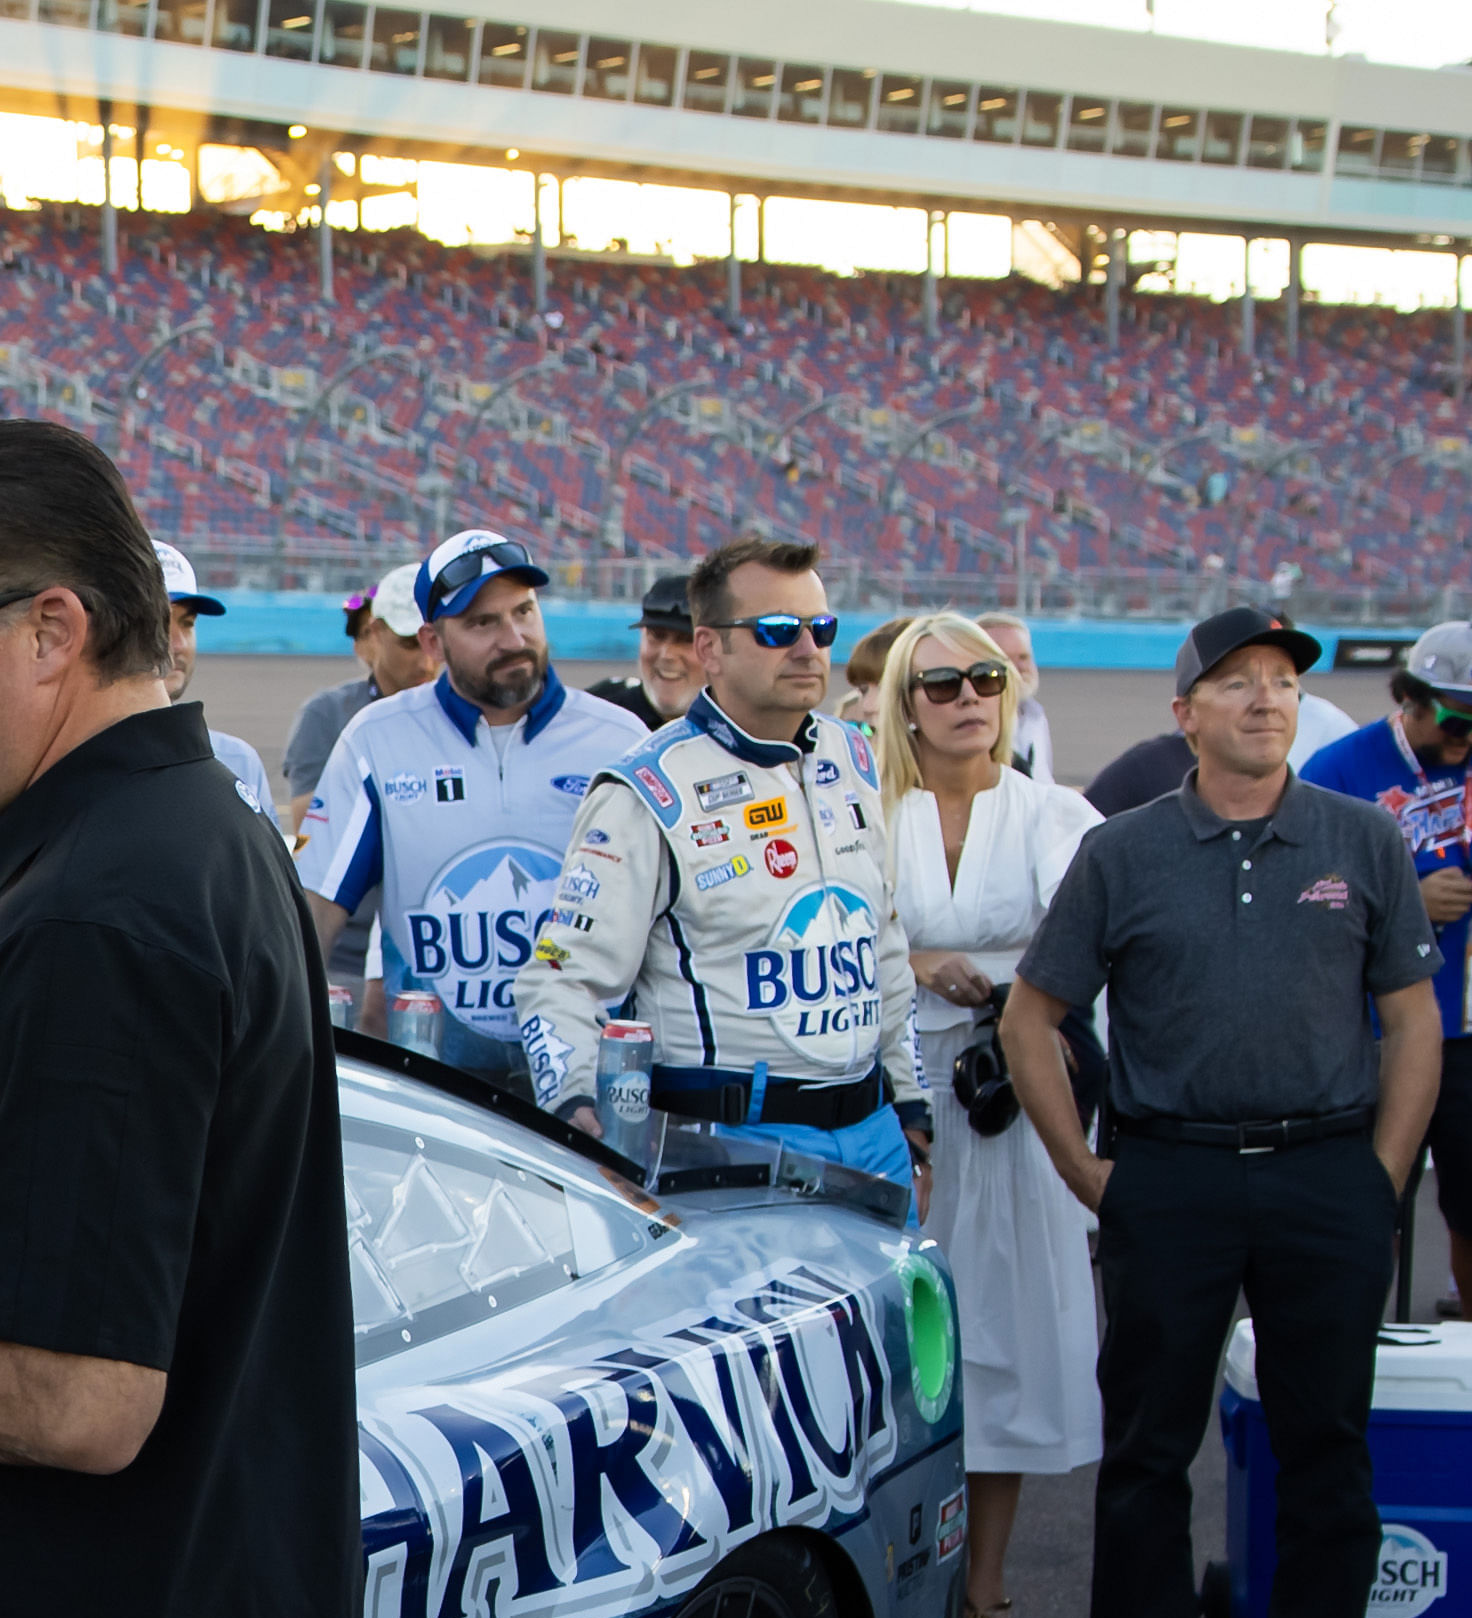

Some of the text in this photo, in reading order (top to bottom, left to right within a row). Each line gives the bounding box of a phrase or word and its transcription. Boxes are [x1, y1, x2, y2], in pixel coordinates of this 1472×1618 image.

[384, 780, 427, 797] BUSCH
[443, 778, 456, 801] 1
[749, 802, 785, 826] GW
[767, 841, 798, 875] Rheem
[696, 855, 750, 890] SUNNYD
[580, 915, 589, 930] 1
[797, 998, 881, 1038] LIGHT
[521, 1014, 558, 1105] BUSCH
[1381, 1558, 1441, 1589] SCH
[1370, 1587, 1419, 1604] IGHT
